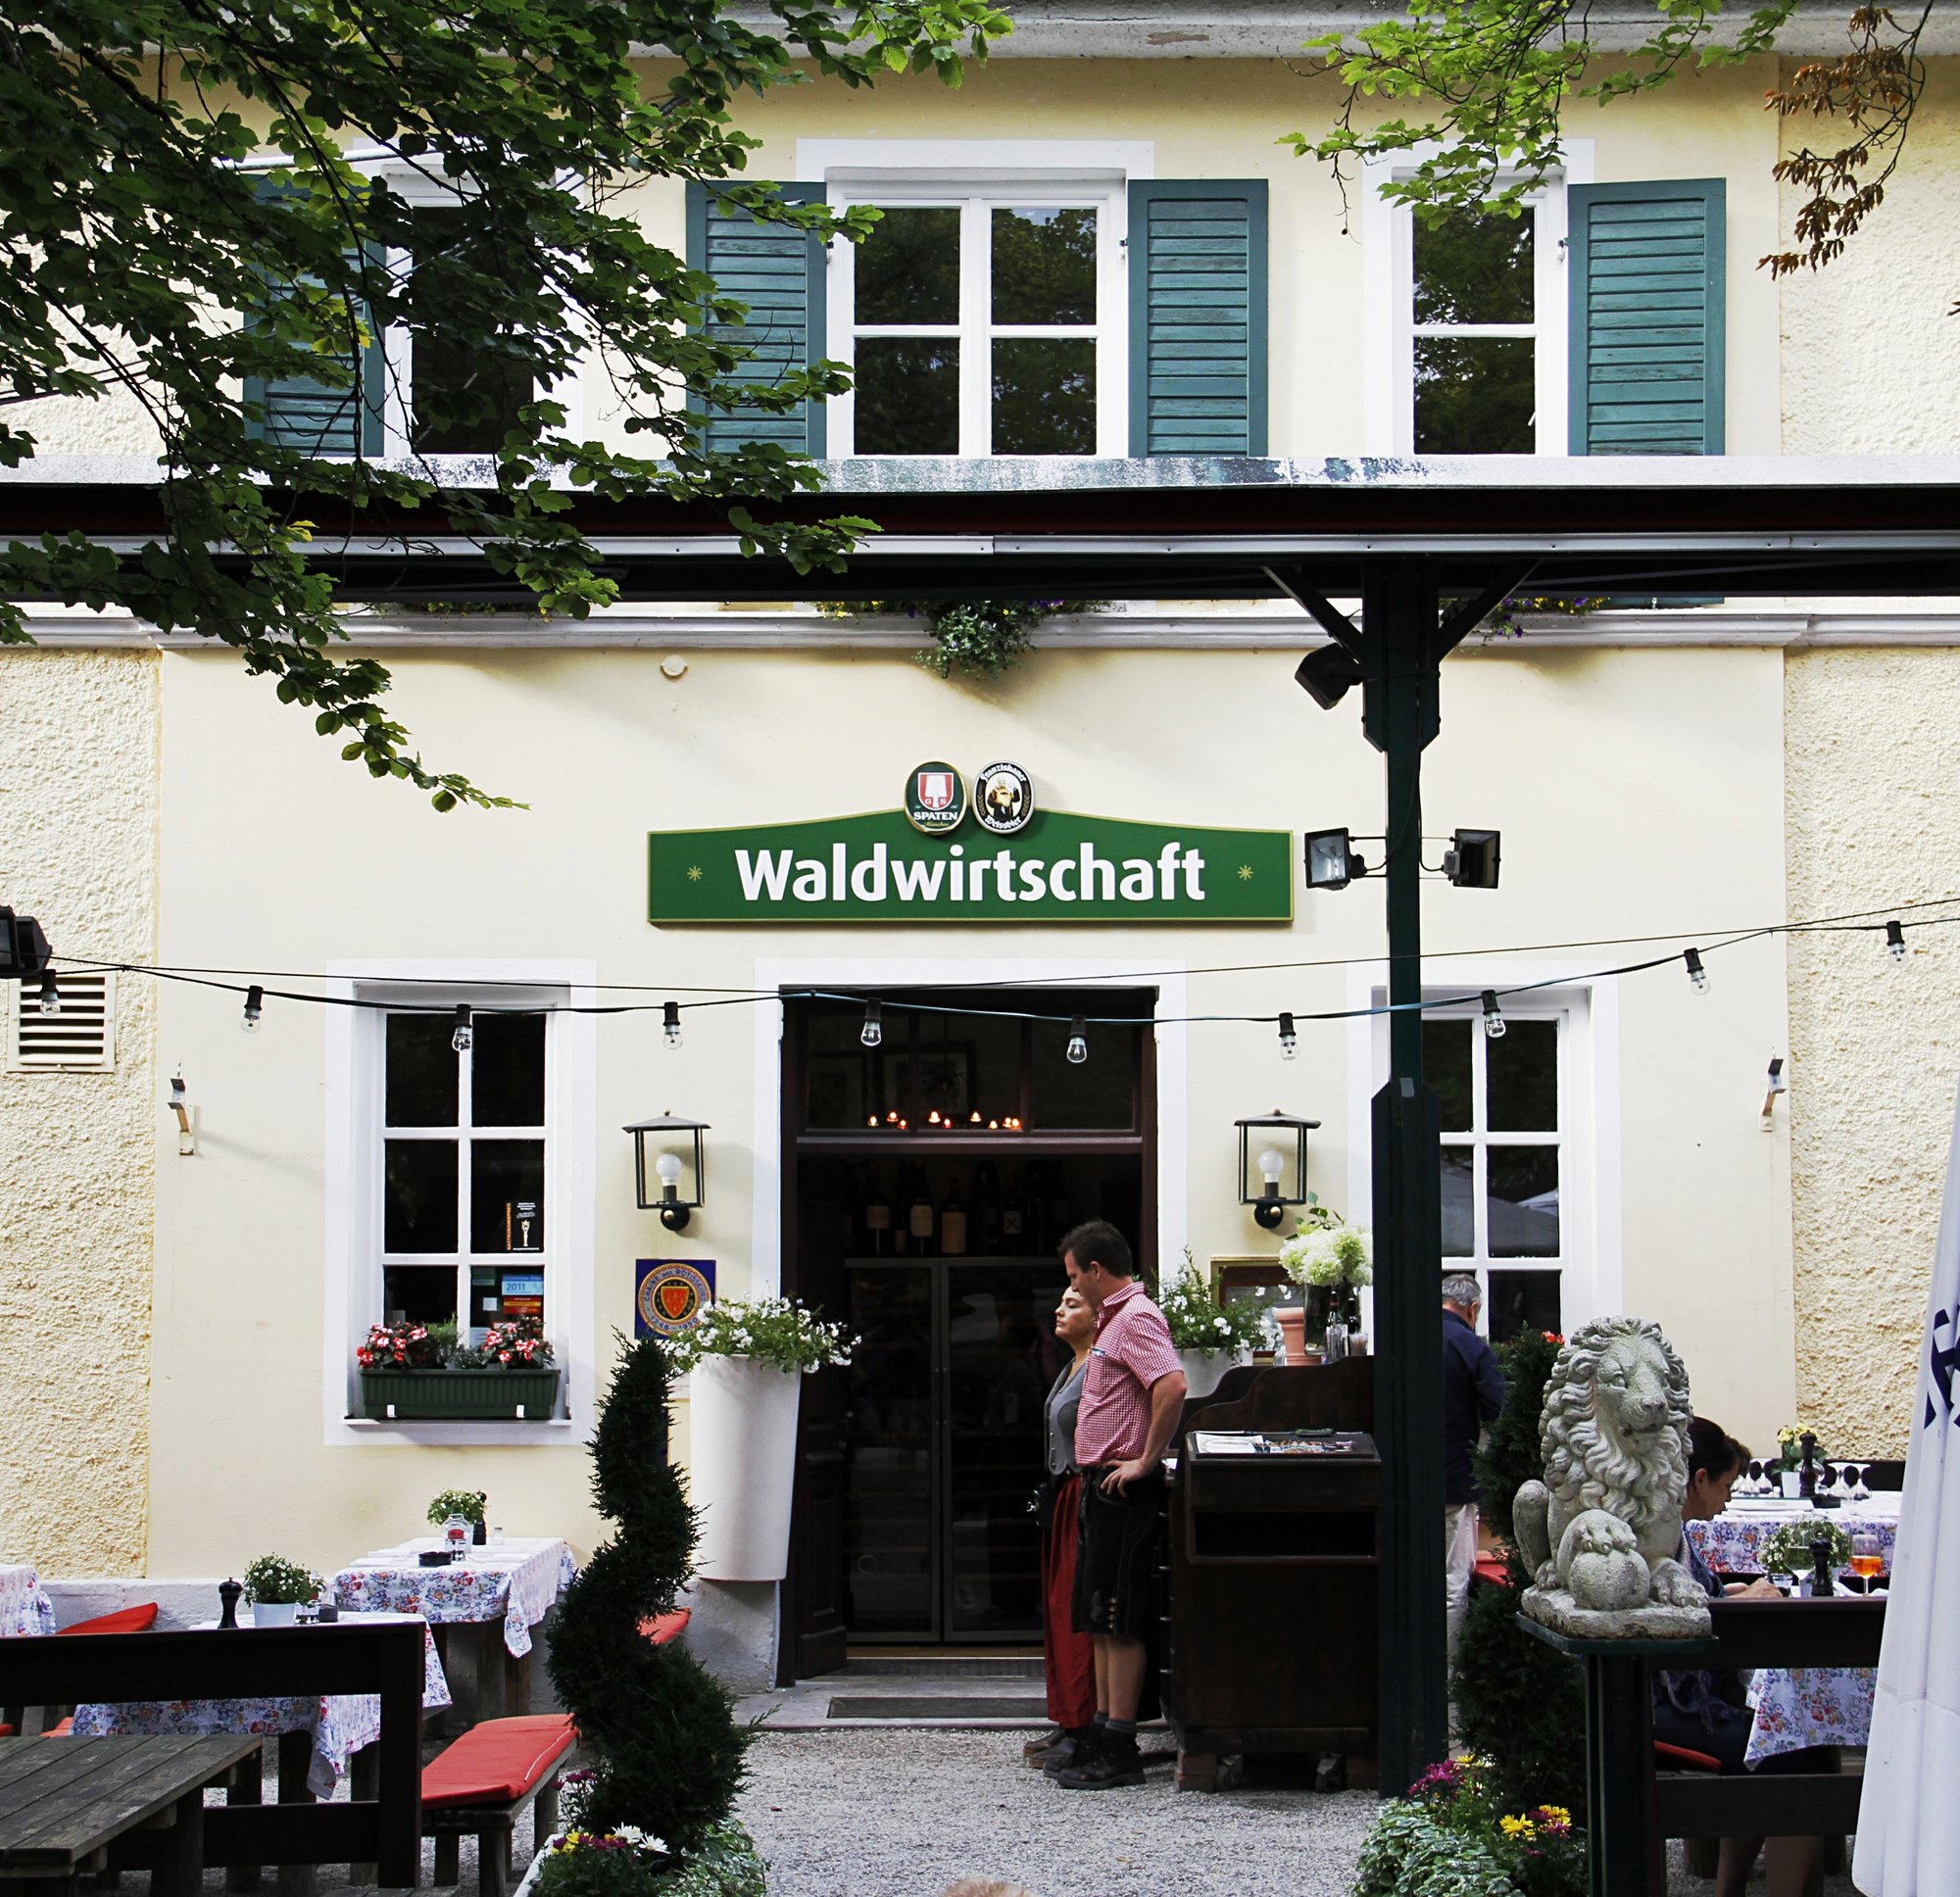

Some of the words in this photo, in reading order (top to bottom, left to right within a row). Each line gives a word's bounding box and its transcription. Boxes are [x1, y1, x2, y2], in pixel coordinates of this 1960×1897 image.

[913, 811, 958, 821] SPATEN
[735, 843, 1205, 901] Waldwirtschaft
[506, 1283, 525, 1291] 2011
